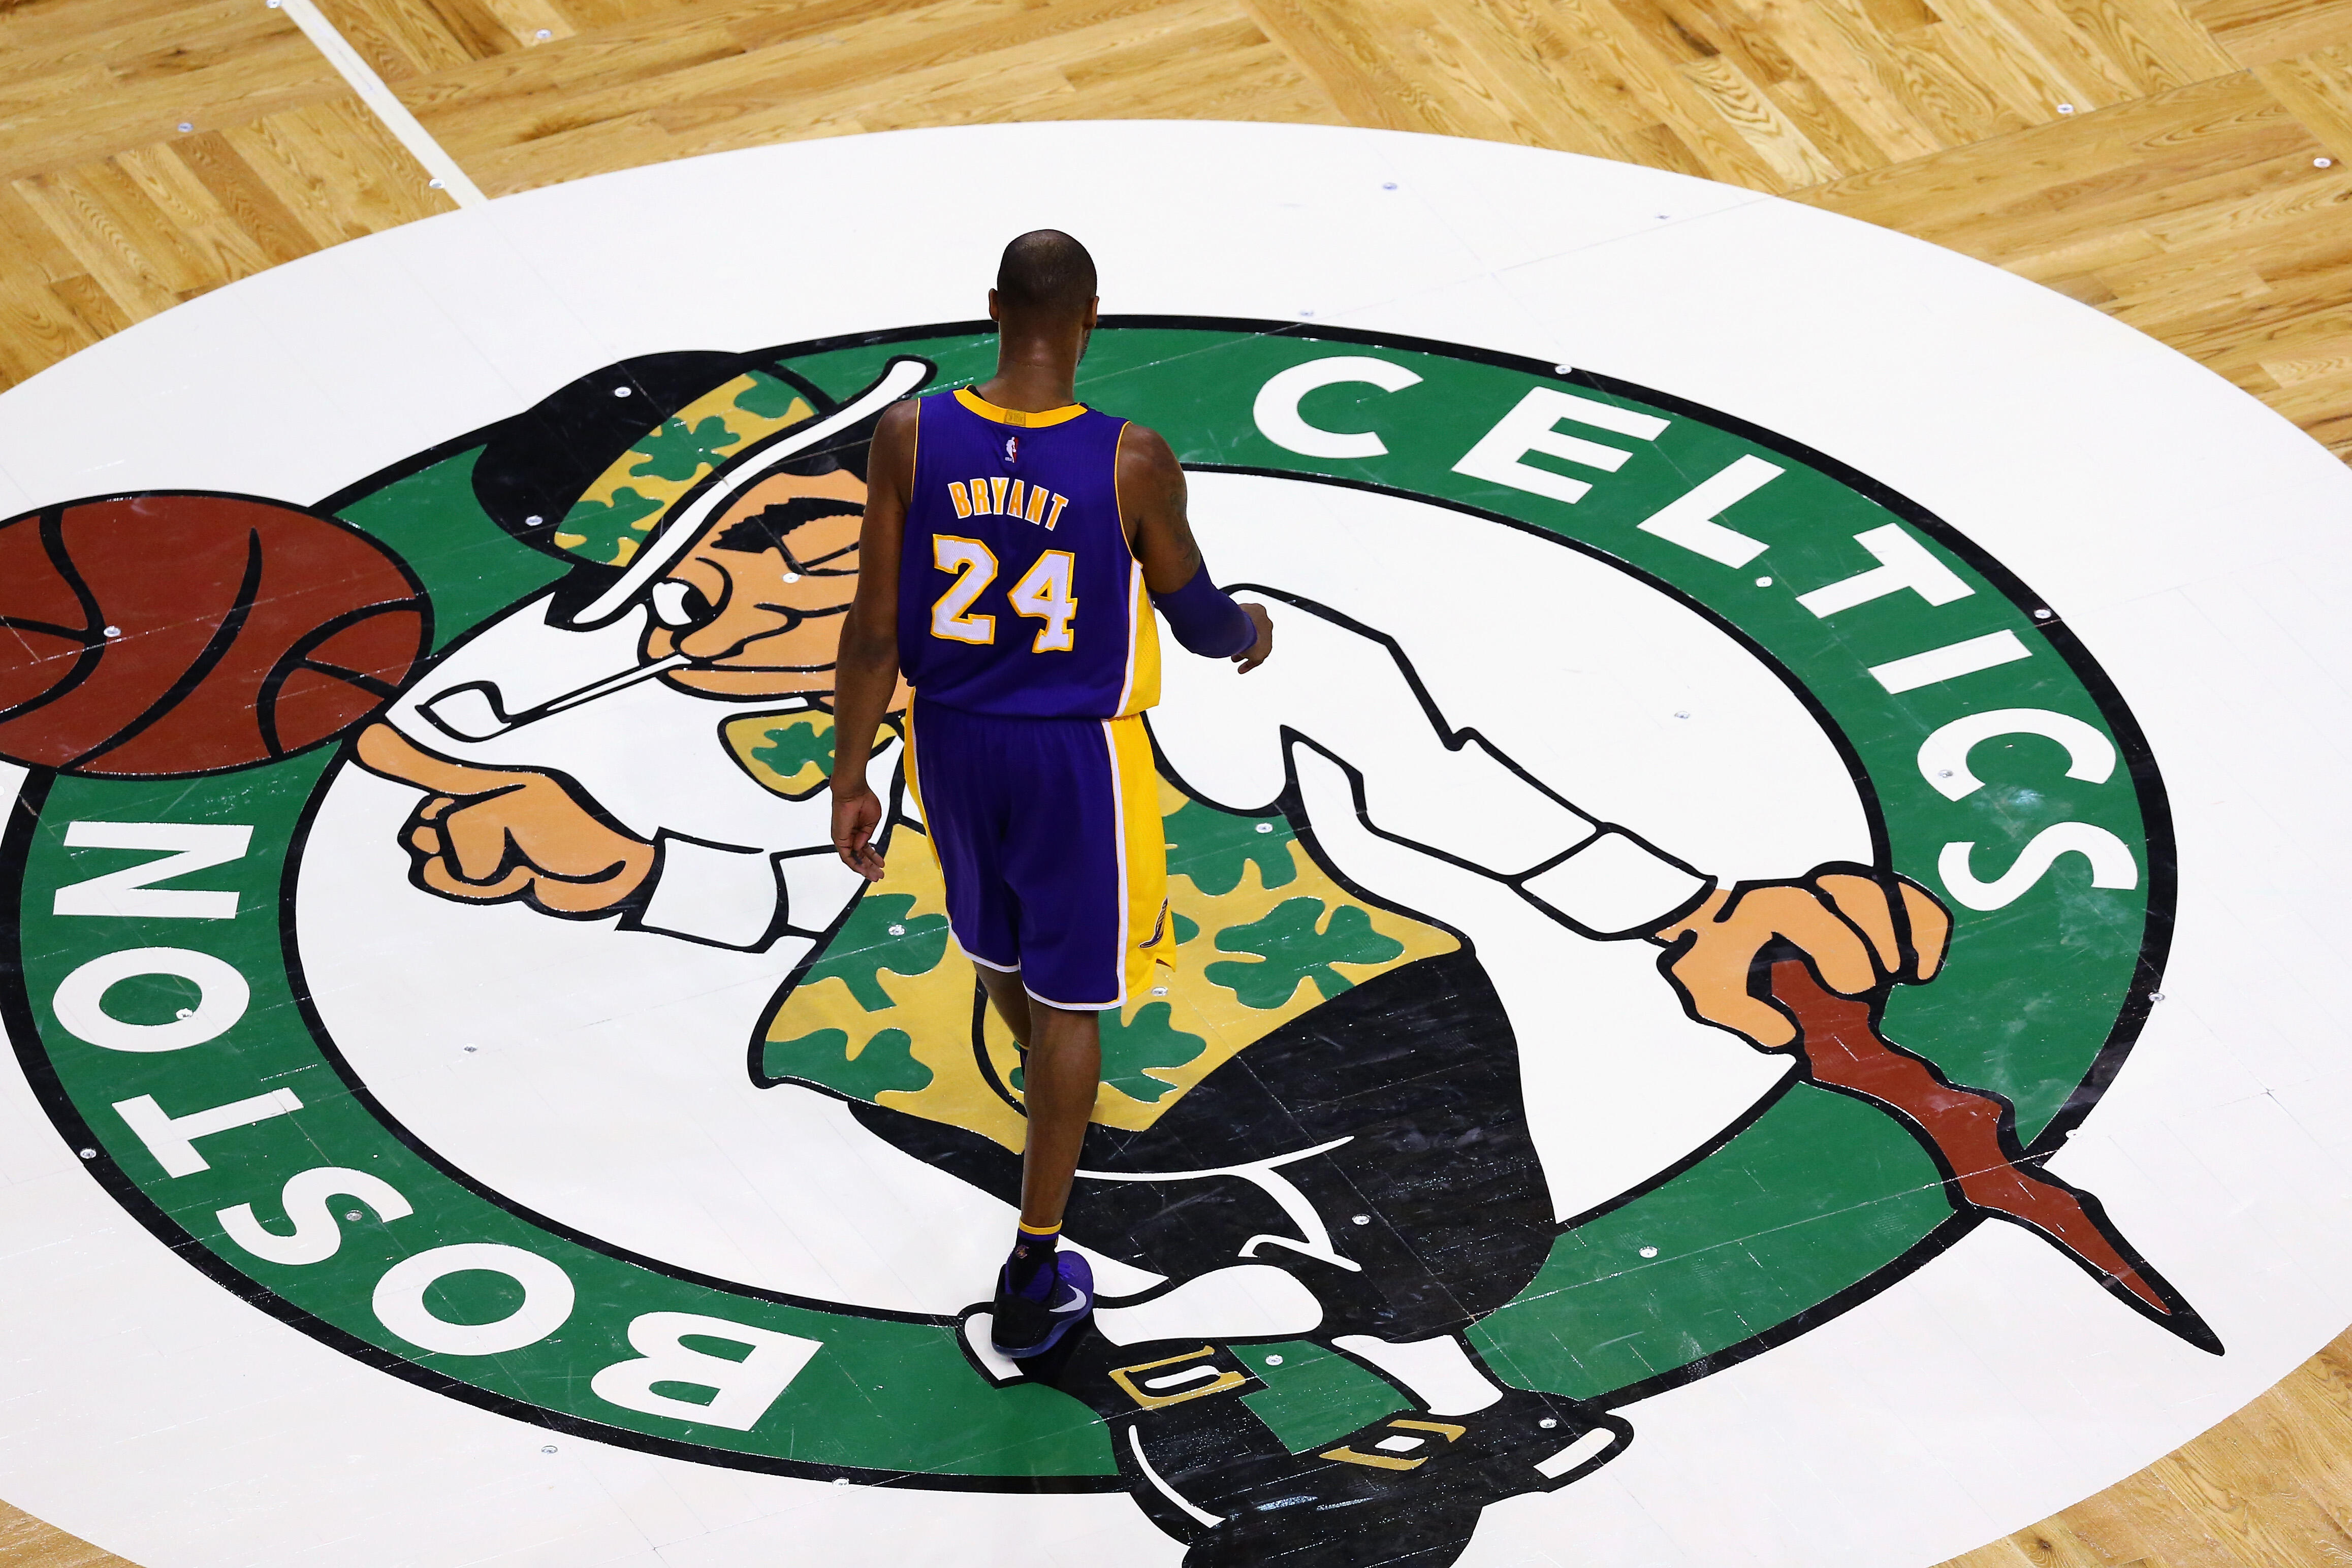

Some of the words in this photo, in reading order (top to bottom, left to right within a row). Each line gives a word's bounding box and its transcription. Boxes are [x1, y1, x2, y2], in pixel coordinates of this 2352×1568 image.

[930, 534, 1077, 653] 24
[947, 476, 1069, 531] BRYANT
[1253, 356, 2138, 911] CELTICS
[52, 821, 823, 1431] BOSTON
